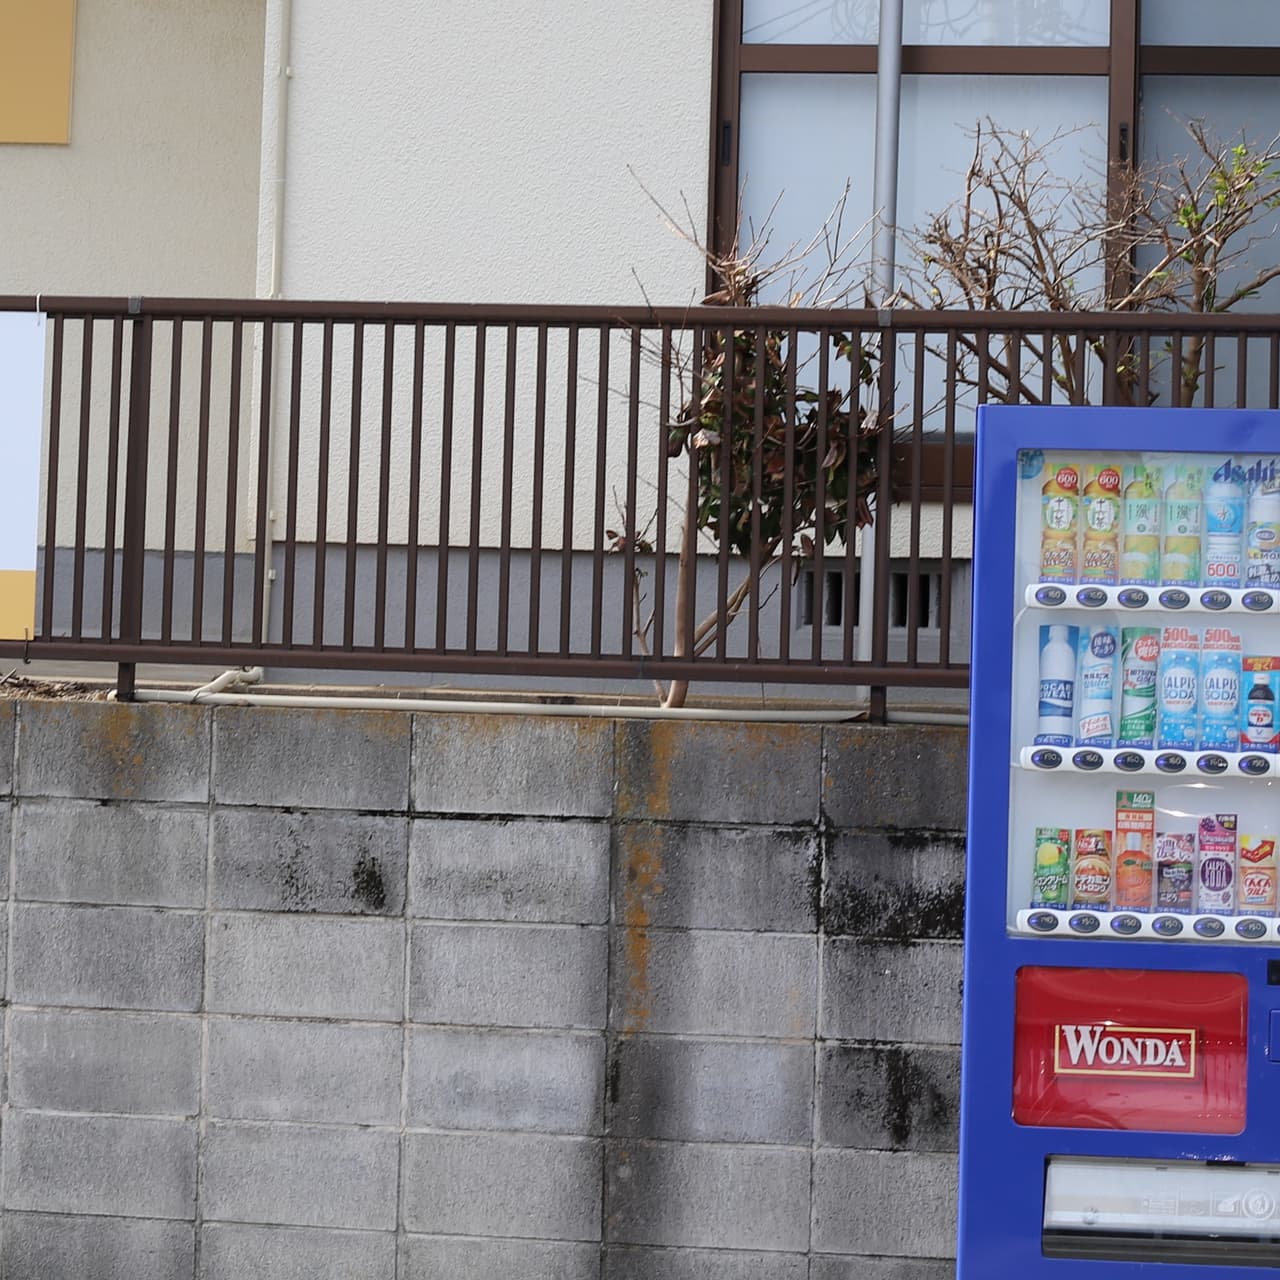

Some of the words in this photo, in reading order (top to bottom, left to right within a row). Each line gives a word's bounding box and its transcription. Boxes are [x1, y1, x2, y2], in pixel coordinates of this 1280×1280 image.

[1213, 458, 1276, 482] Asahi
[1057, 475, 1077, 484] 600
[1099, 476, 1119, 485] 600
[1163, 677, 1196, 689] CALPIS
[1205, 677, 1238, 690] CALPIS
[1163, 690, 1195, 700] SODA
[1205, 690, 1237, 701] SODA
[1061, 1025, 1187, 1067] WONDA
